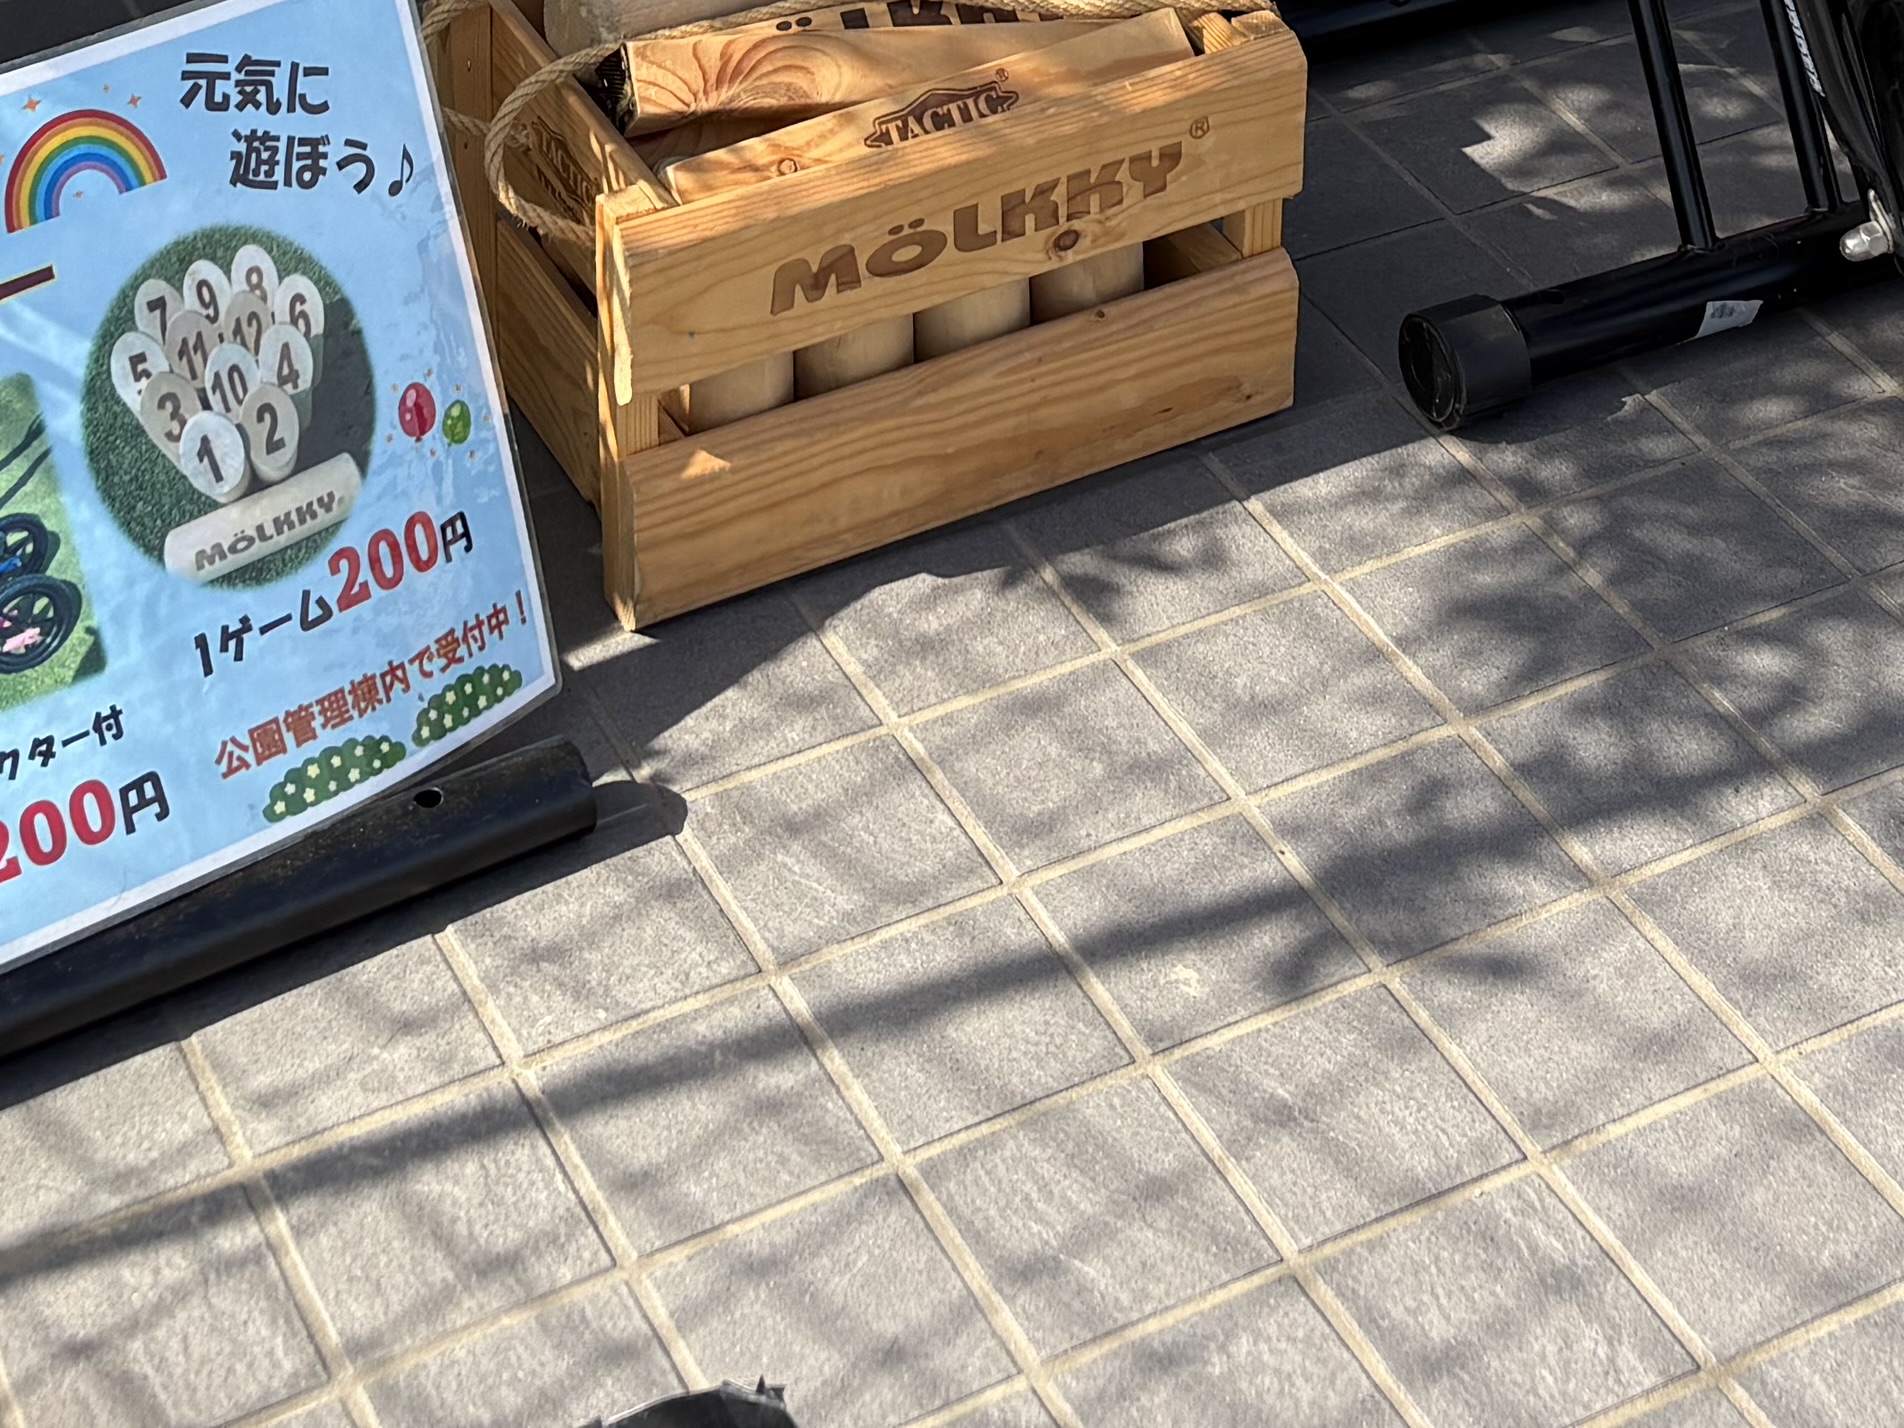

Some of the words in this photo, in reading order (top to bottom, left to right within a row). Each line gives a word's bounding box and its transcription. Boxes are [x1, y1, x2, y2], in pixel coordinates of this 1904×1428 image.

[179, 52, 330, 115] 元気に
[881, 89, 999, 146] TACTIC
[146, 296, 168, 345] 7
[195, 278, 220, 325] 9
[288, 292, 311, 338] 6
[177, 330, 209, 381] 11
[232, 310, 263, 360] 12
[129, 350, 151, 386] 5
[212, 363, 249, 414] 10
[276, 341, 300, 391] 4
[157, 391, 187, 443] 3
[256, 402, 286, 456] 2
[198, 434, 225, 485] 1
[193, 510, 474, 678] 1ゲーム200円
